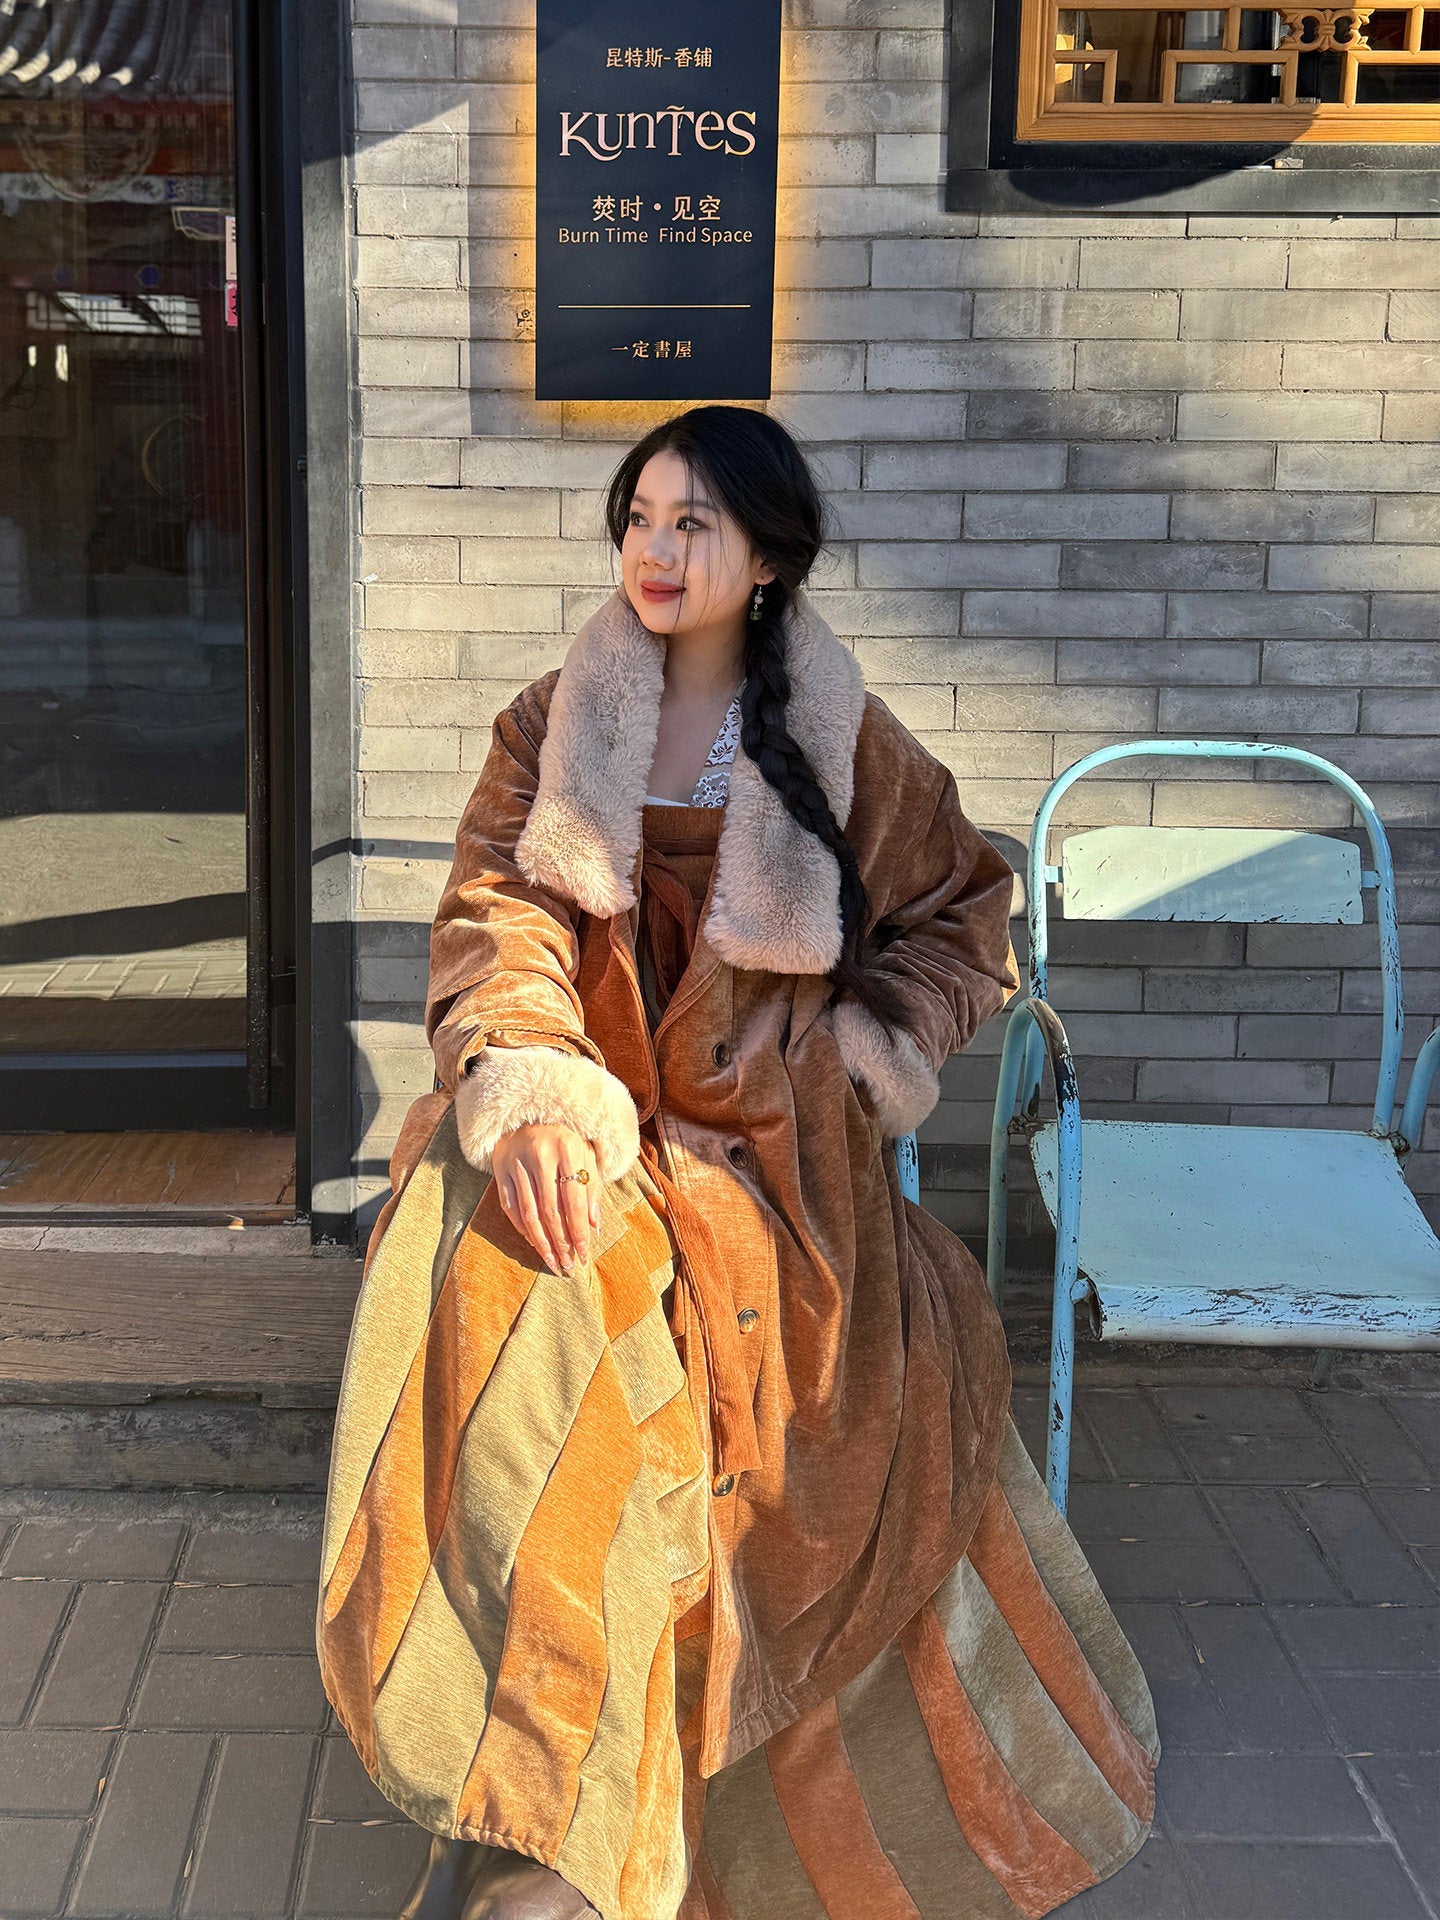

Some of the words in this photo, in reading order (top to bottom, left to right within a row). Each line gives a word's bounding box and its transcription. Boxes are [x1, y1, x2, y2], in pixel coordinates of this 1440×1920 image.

[558, 227, 600, 244] Burn
[604, 227, 649, 244] Time
[659, 226, 696, 244] Find
[700, 227, 753, 247] Space
[611, 339, 692, 359] 一定書屋
